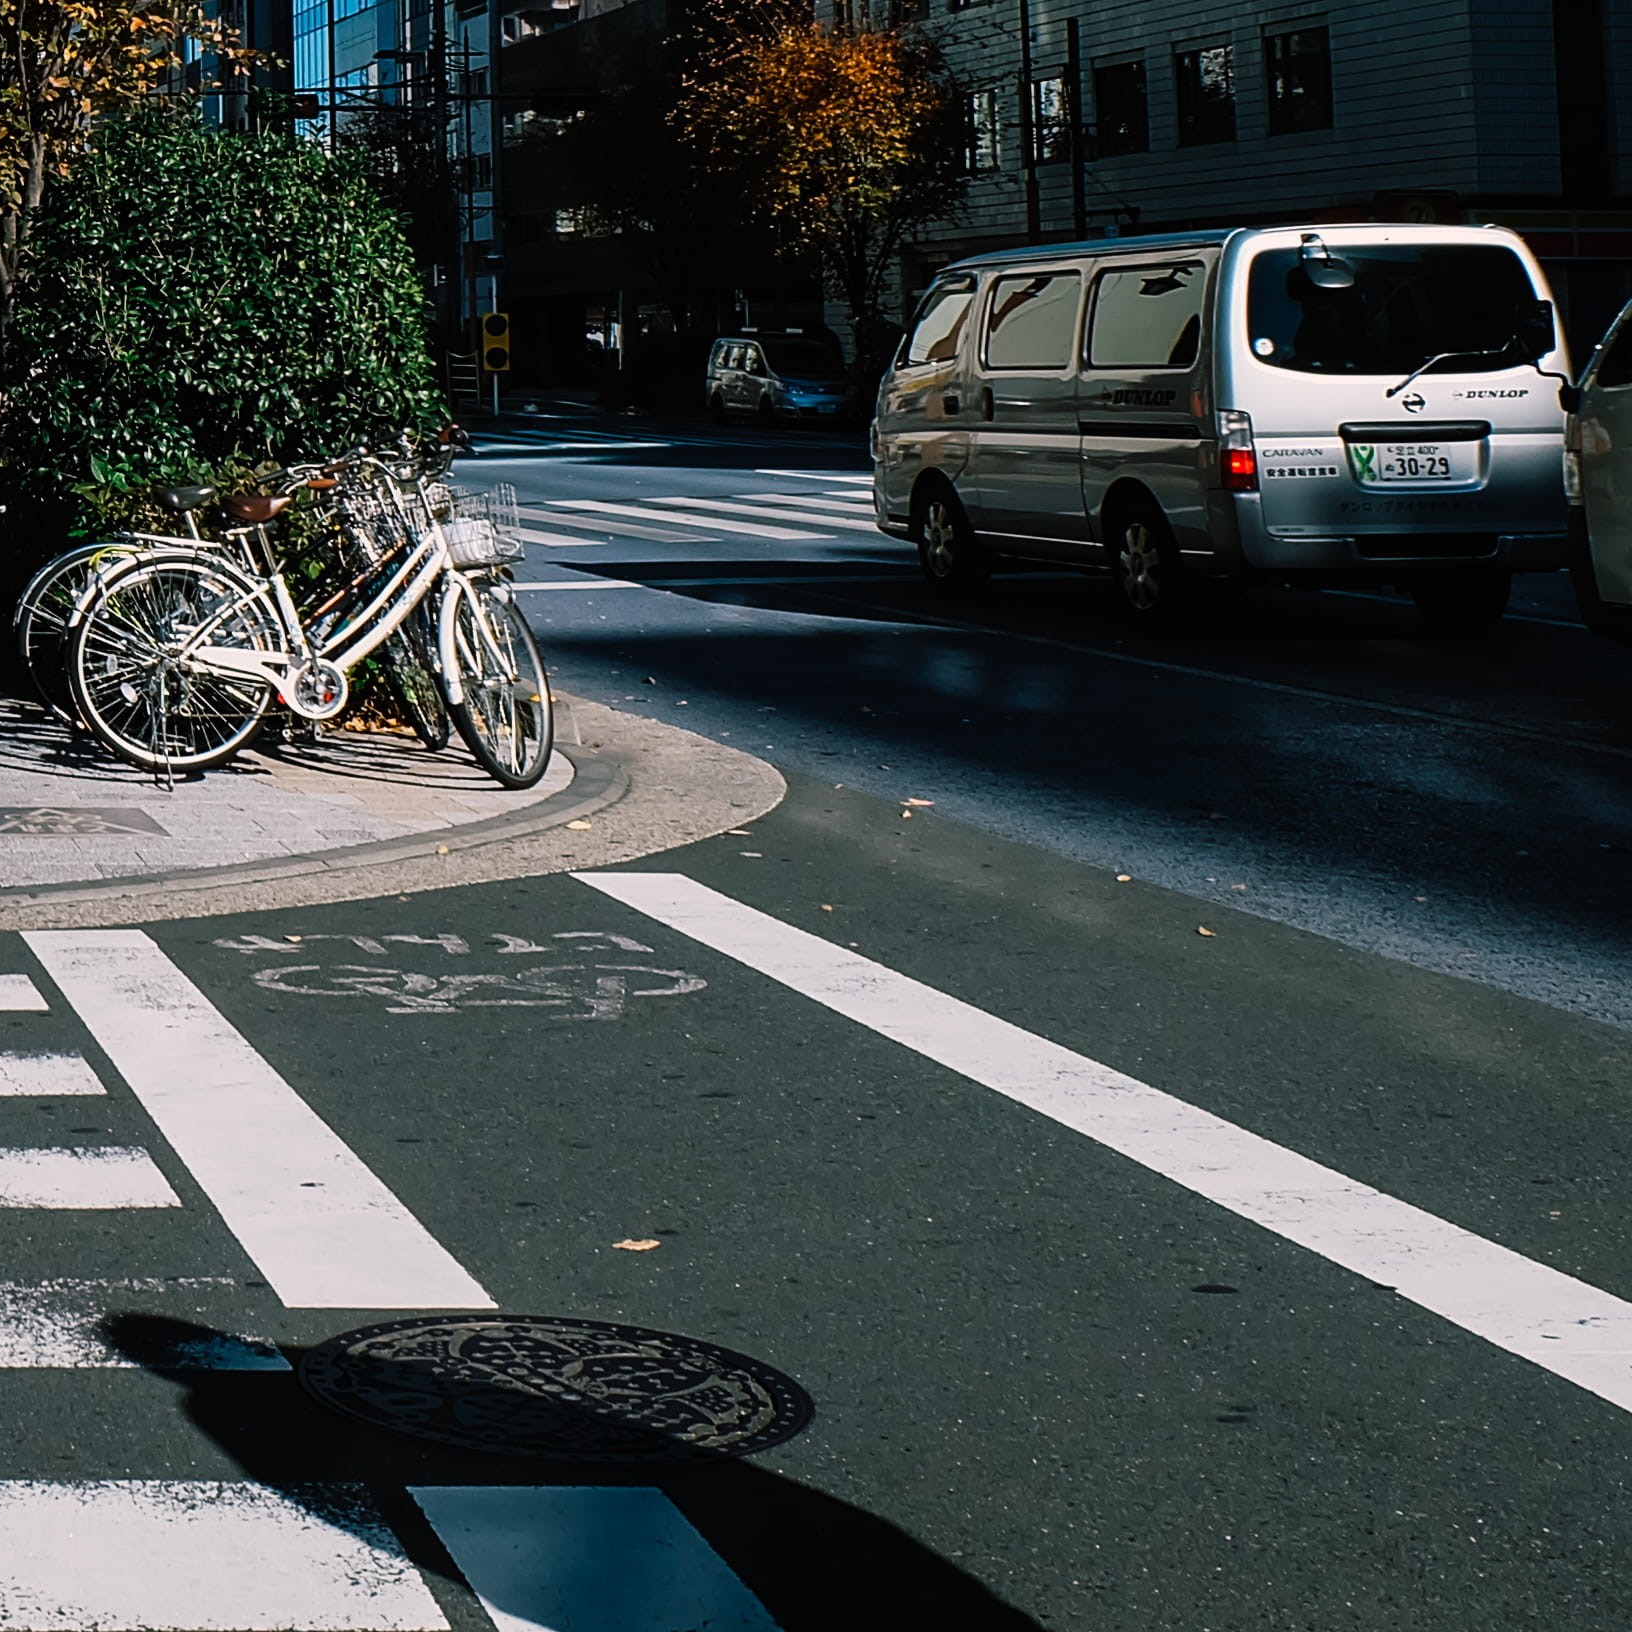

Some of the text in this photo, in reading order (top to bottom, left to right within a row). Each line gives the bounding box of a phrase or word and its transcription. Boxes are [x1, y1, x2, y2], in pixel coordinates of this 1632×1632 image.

[1112, 389, 1176, 406] DUNLOP
[1466, 389, 1529, 399] DUNLOP
[1262, 448, 1323, 458] CARAVAN
[1395, 456, 1450, 476] 30-29
